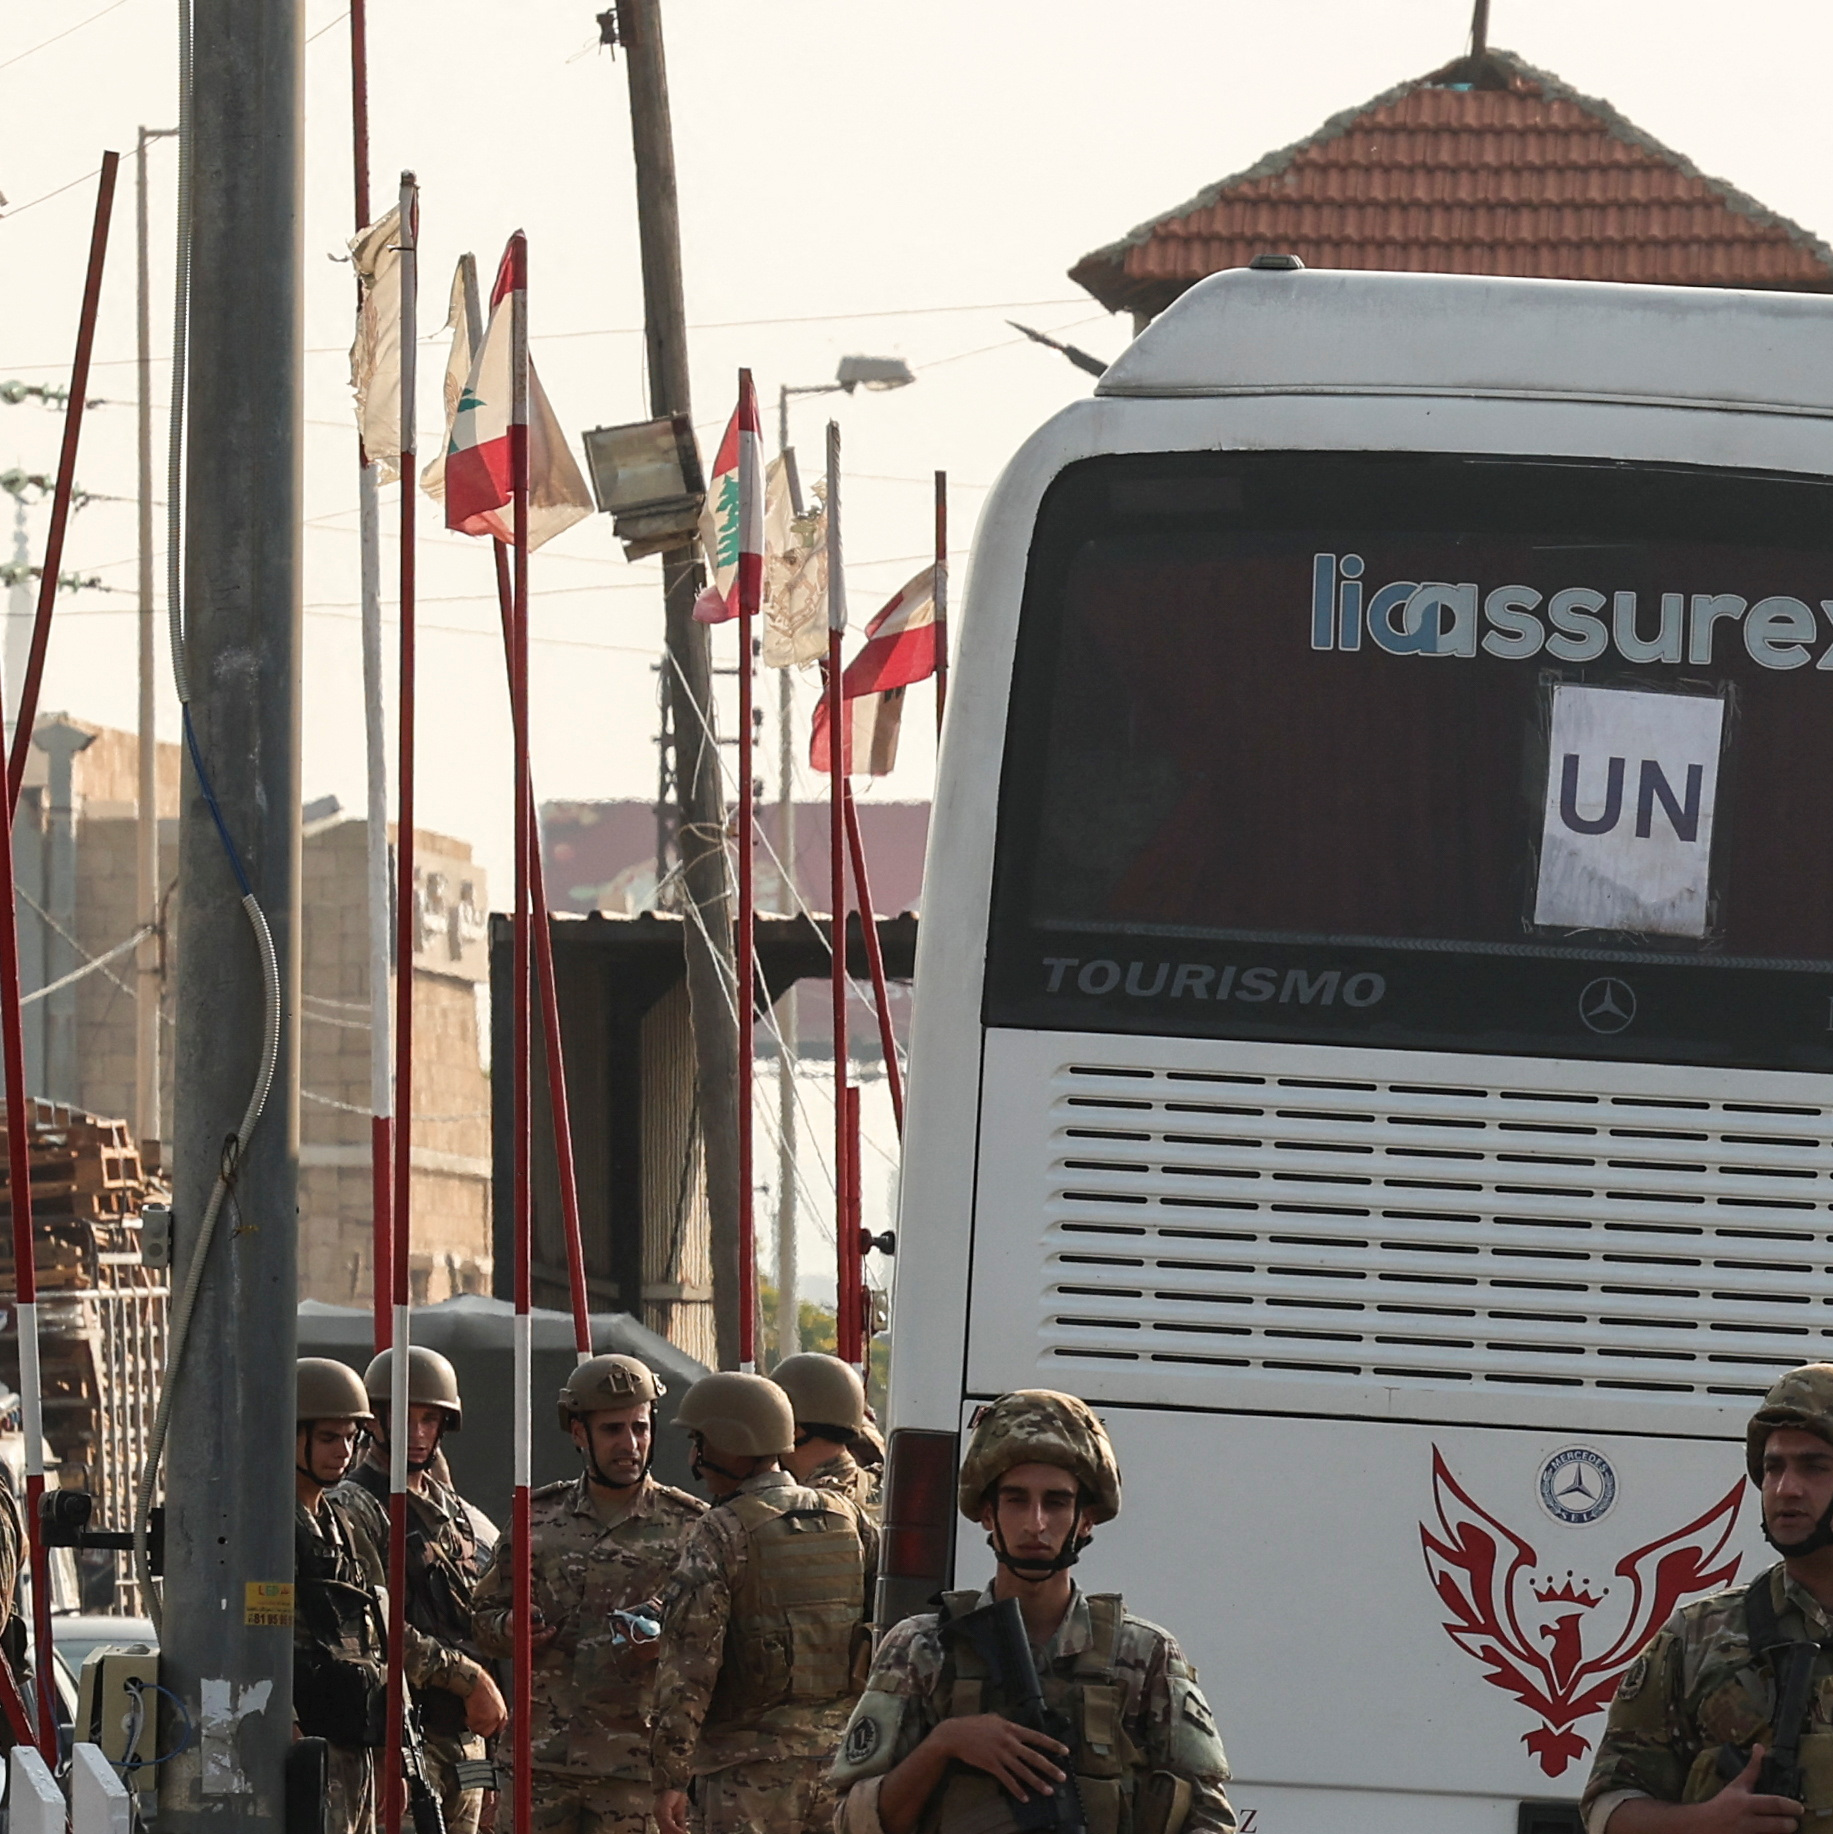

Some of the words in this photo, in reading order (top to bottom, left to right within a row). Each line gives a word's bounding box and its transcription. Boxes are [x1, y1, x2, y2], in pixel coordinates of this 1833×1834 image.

[1559, 753, 1704, 843] UN
[1042, 957, 1387, 1007] TOURISMO
[1551, 1450, 1609, 1472] MERCEDES
